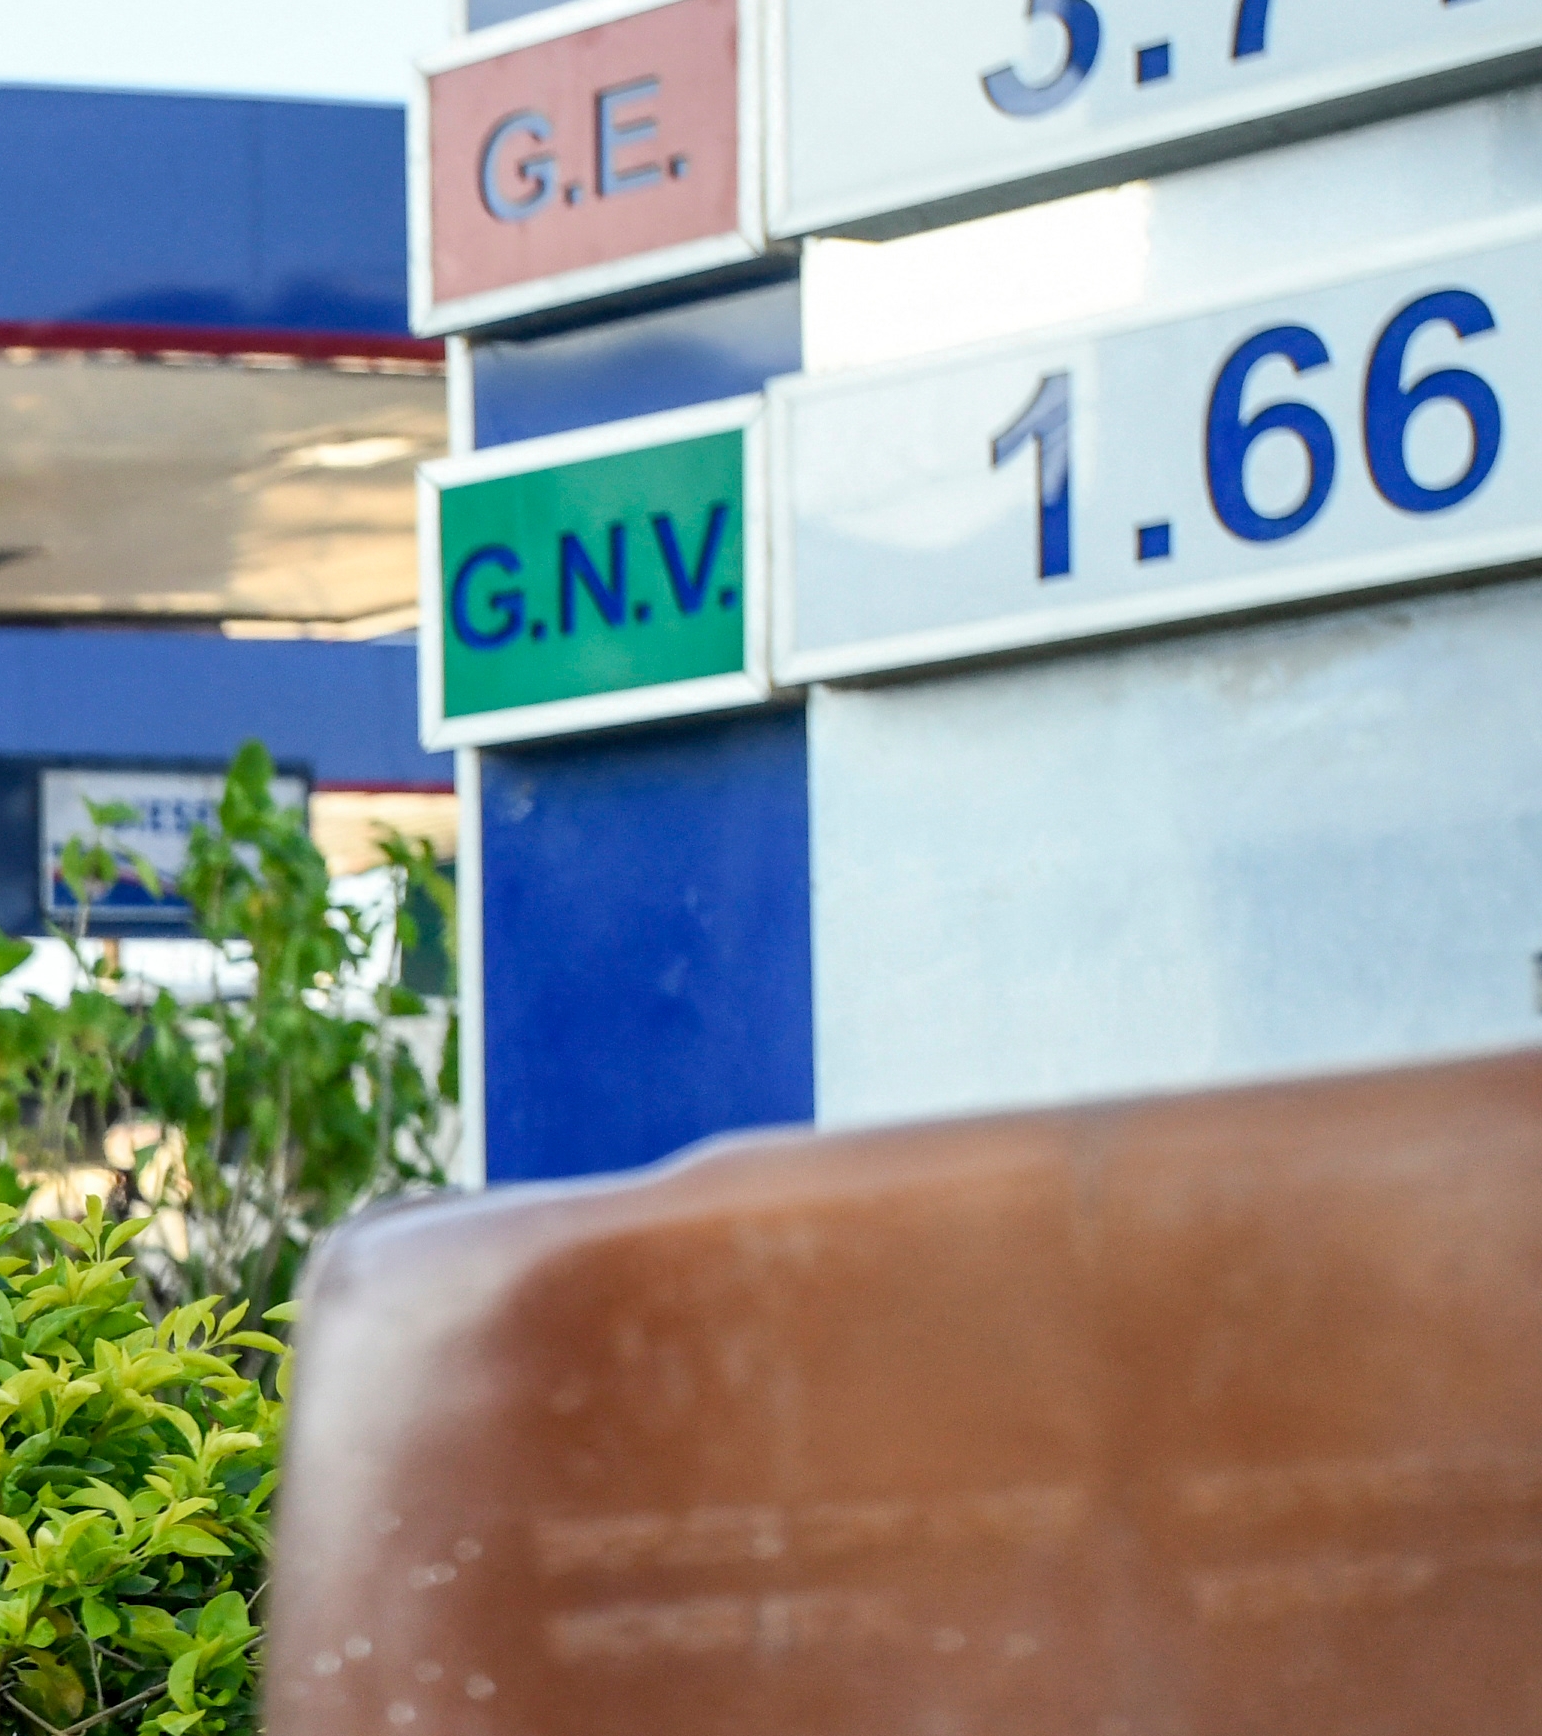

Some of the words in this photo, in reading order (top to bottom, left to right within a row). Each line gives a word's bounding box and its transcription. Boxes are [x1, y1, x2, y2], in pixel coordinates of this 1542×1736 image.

[479, 77, 690, 223] G.E.
[991, 289, 1504, 581] 1.66
[451, 500, 743, 651] G.N.V.
